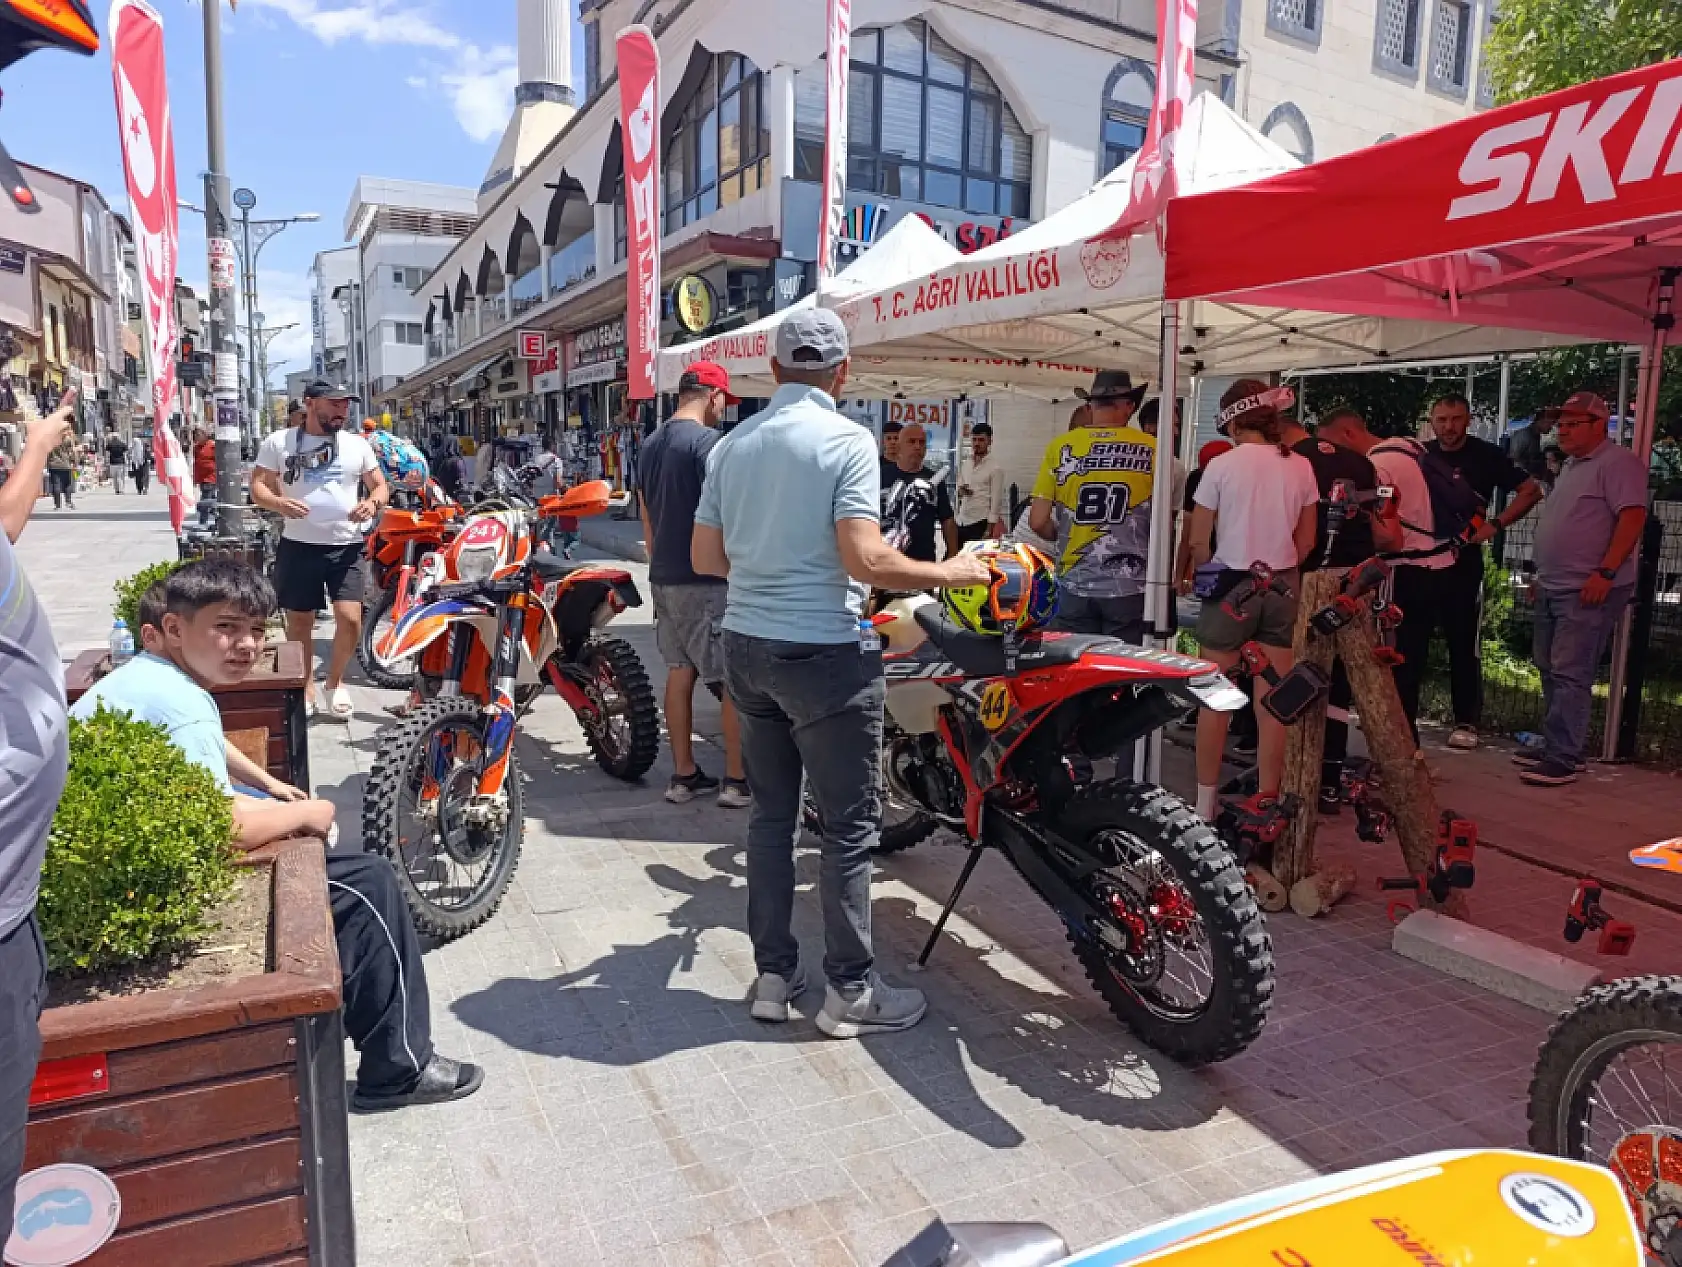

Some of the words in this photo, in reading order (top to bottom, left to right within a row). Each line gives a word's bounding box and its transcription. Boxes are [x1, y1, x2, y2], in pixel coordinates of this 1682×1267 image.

[913, 273, 960, 314] AĞRI
[965, 247, 1060, 303] VALİLİĞİ
[525, 336, 541, 353] E
[1075, 483, 1131, 524] 81
[468, 524, 499, 539] 241
[981, 689, 1006, 720] 44
